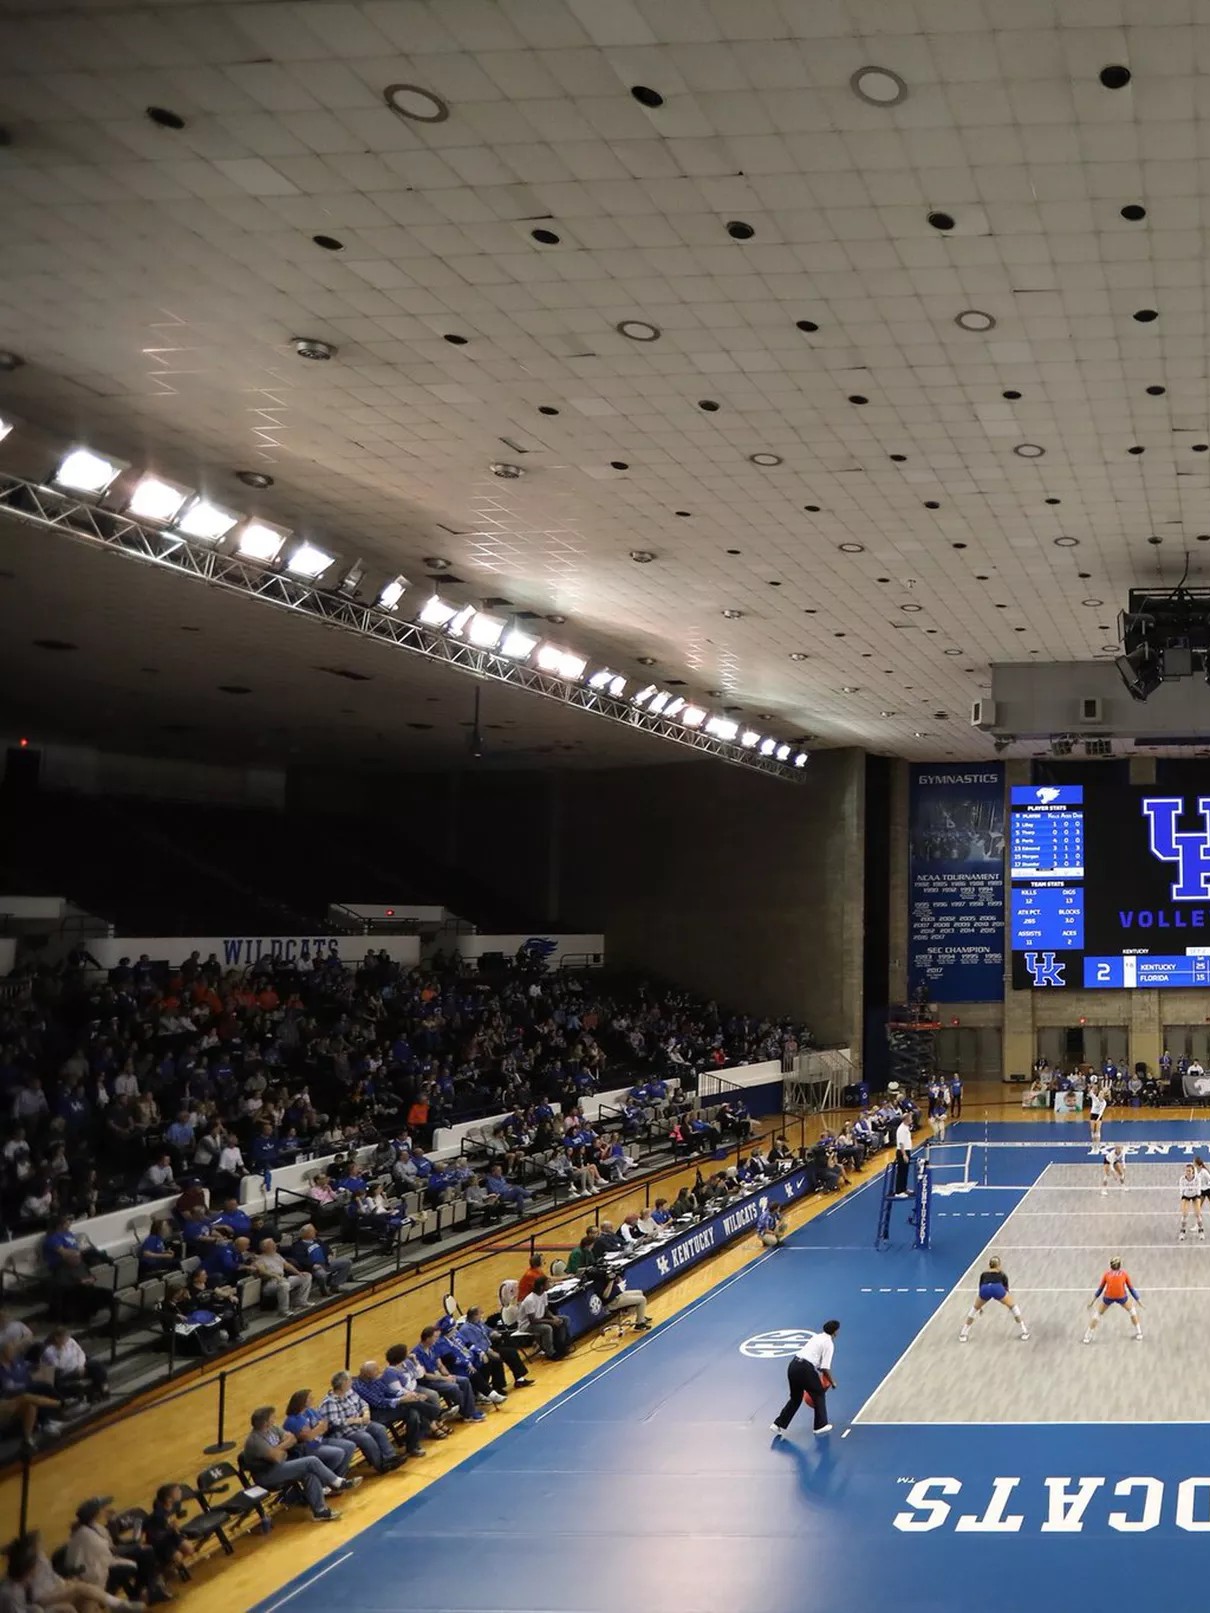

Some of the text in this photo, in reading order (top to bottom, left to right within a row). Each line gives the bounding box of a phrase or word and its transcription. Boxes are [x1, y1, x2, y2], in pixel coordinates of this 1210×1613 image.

[918, 774, 998, 784] GYMNASTICS
[223, 939, 338, 965] WILDCATS
[1025, 952, 1065, 986] UK
[1097, 963, 1110, 981] 2
[671, 1226, 715, 1268] KENTUCKY
[723, 1202, 758, 1236] WILDCATS
